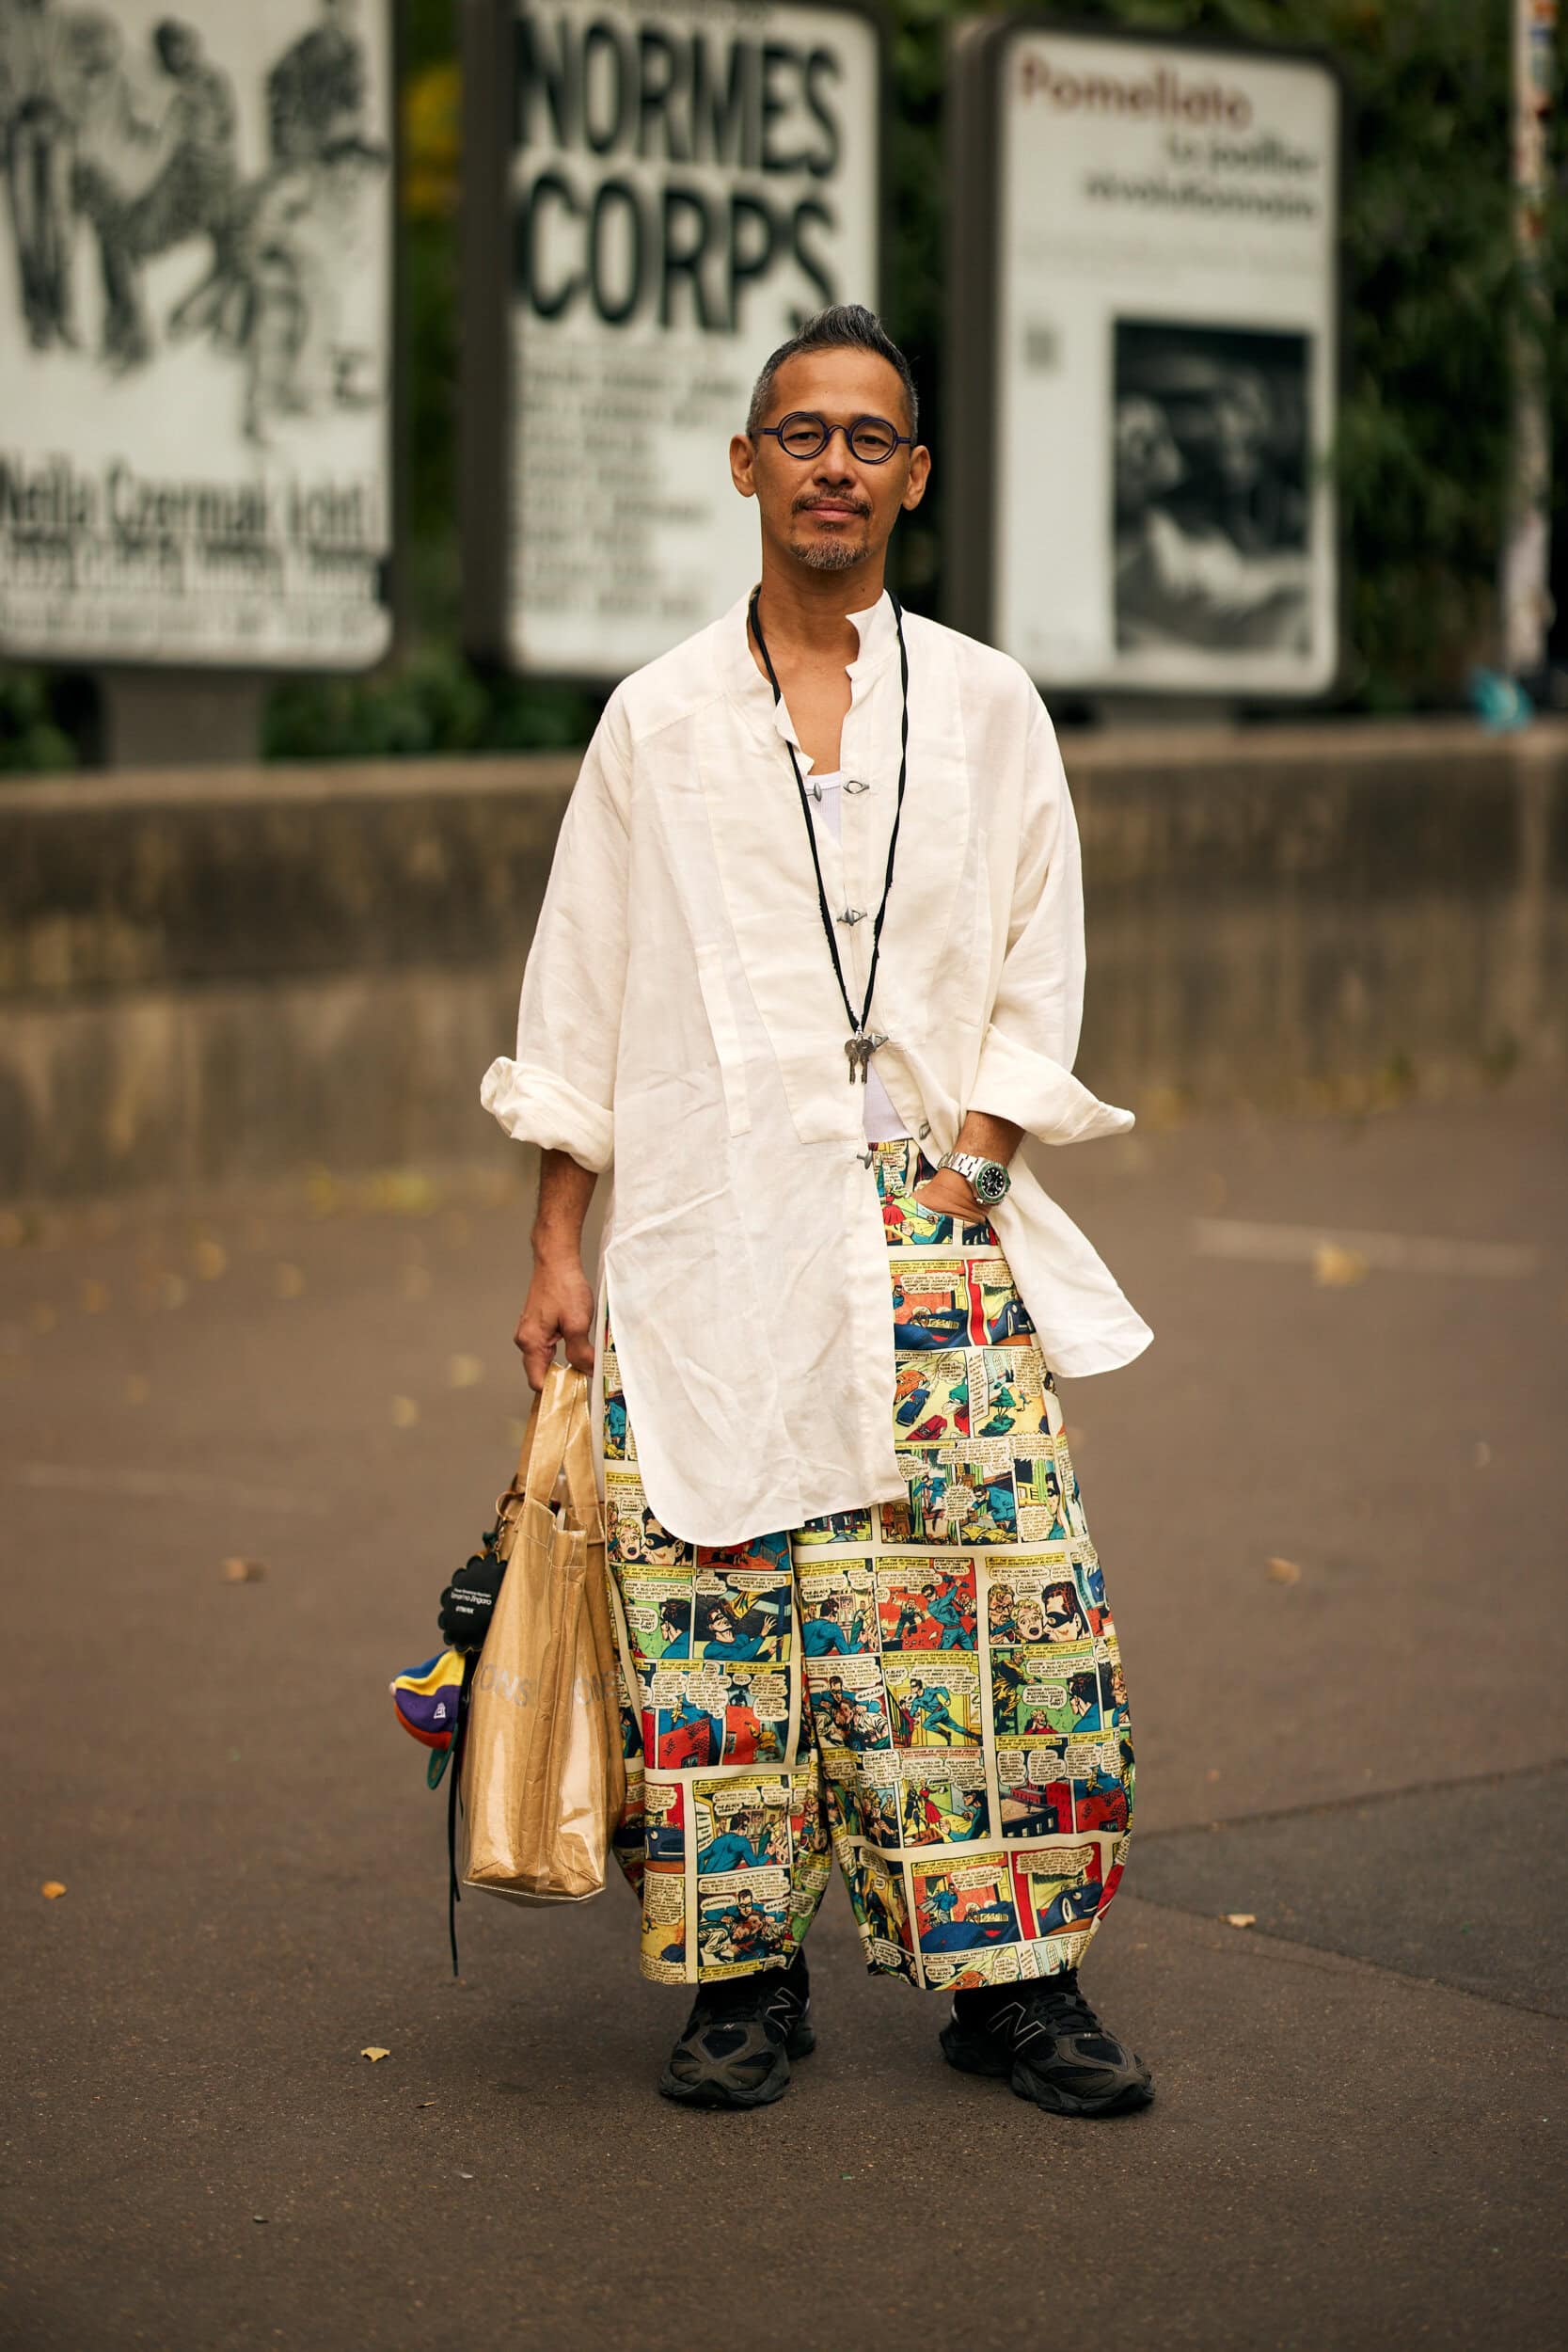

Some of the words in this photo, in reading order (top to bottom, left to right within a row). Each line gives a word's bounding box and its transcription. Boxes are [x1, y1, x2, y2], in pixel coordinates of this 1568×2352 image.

[512, 17, 840, 180] NORMES
[1022, 49, 1254, 132] Pomellato
[517, 172, 837, 336] CORPS
